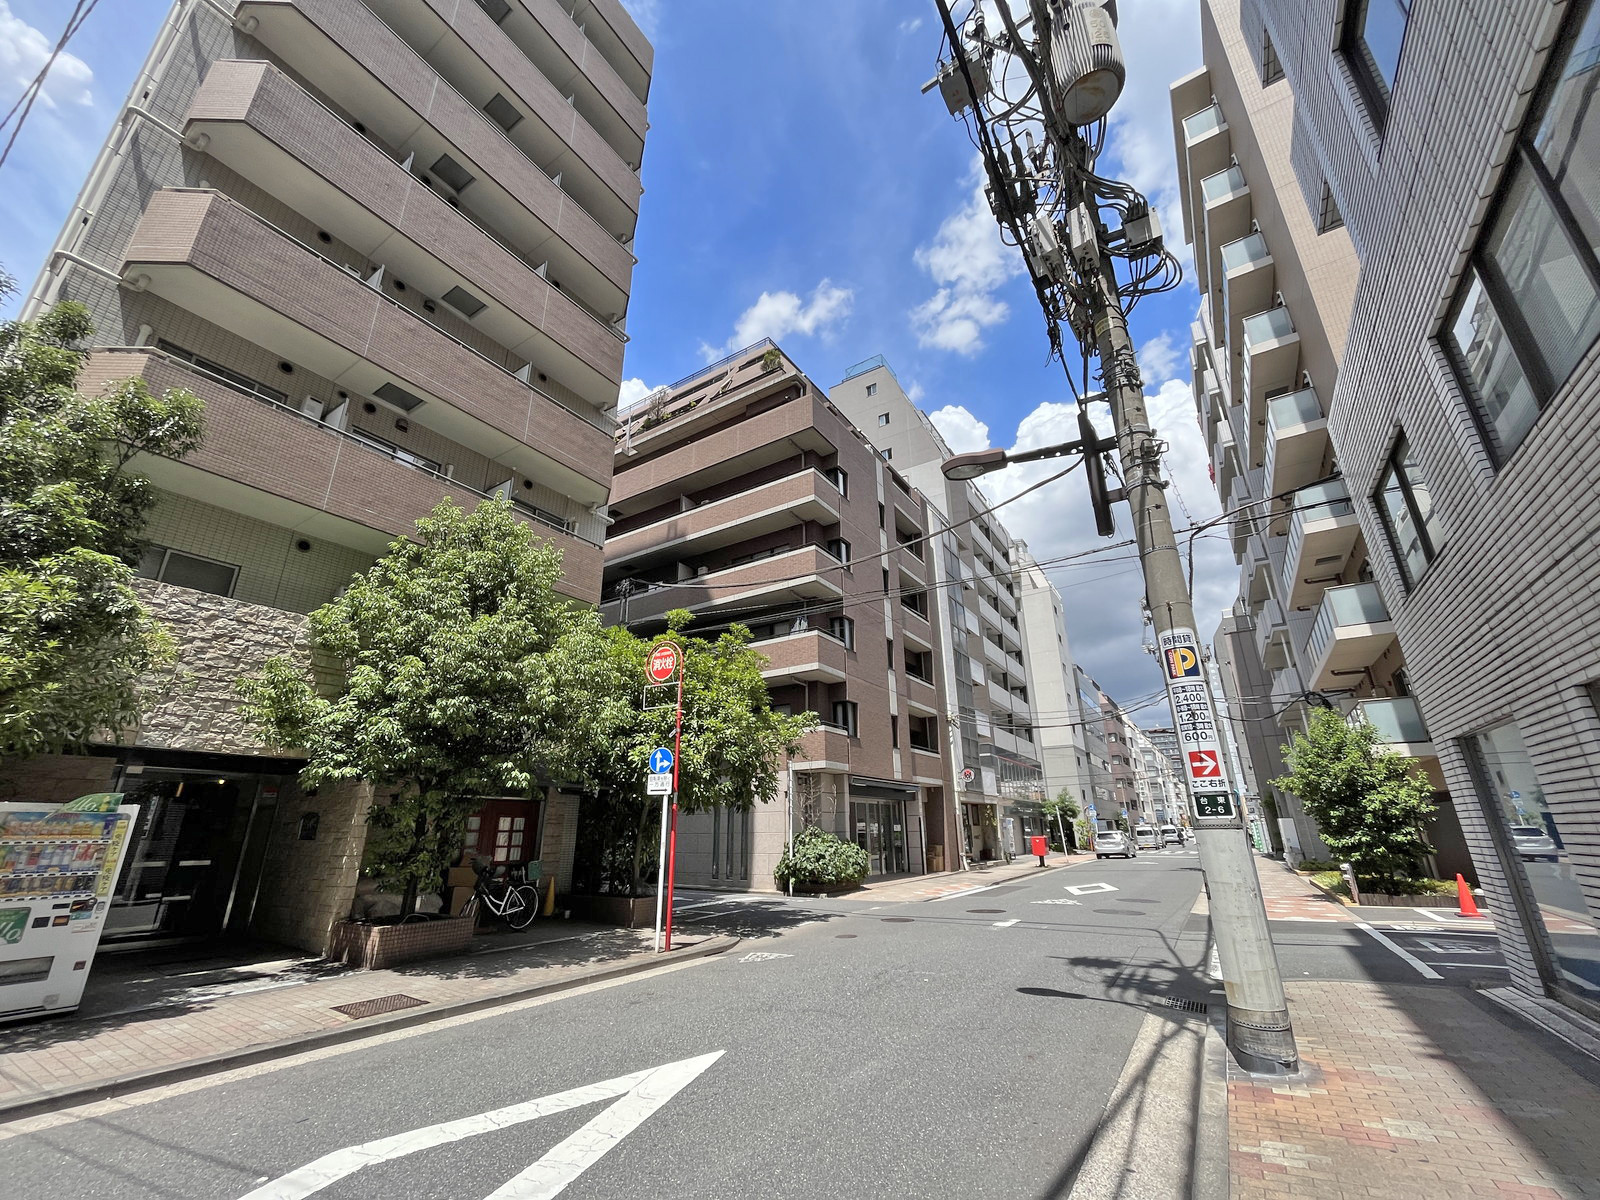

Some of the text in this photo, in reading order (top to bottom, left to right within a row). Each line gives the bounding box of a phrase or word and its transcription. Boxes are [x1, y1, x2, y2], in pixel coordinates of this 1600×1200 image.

[1163, 634, 1192, 646] 時間貸
[653, 656, 674, 671] 消火栓
[1191, 778, 1226, 788] ここ右折
[1204, 806, 1225, 814] 2-6
